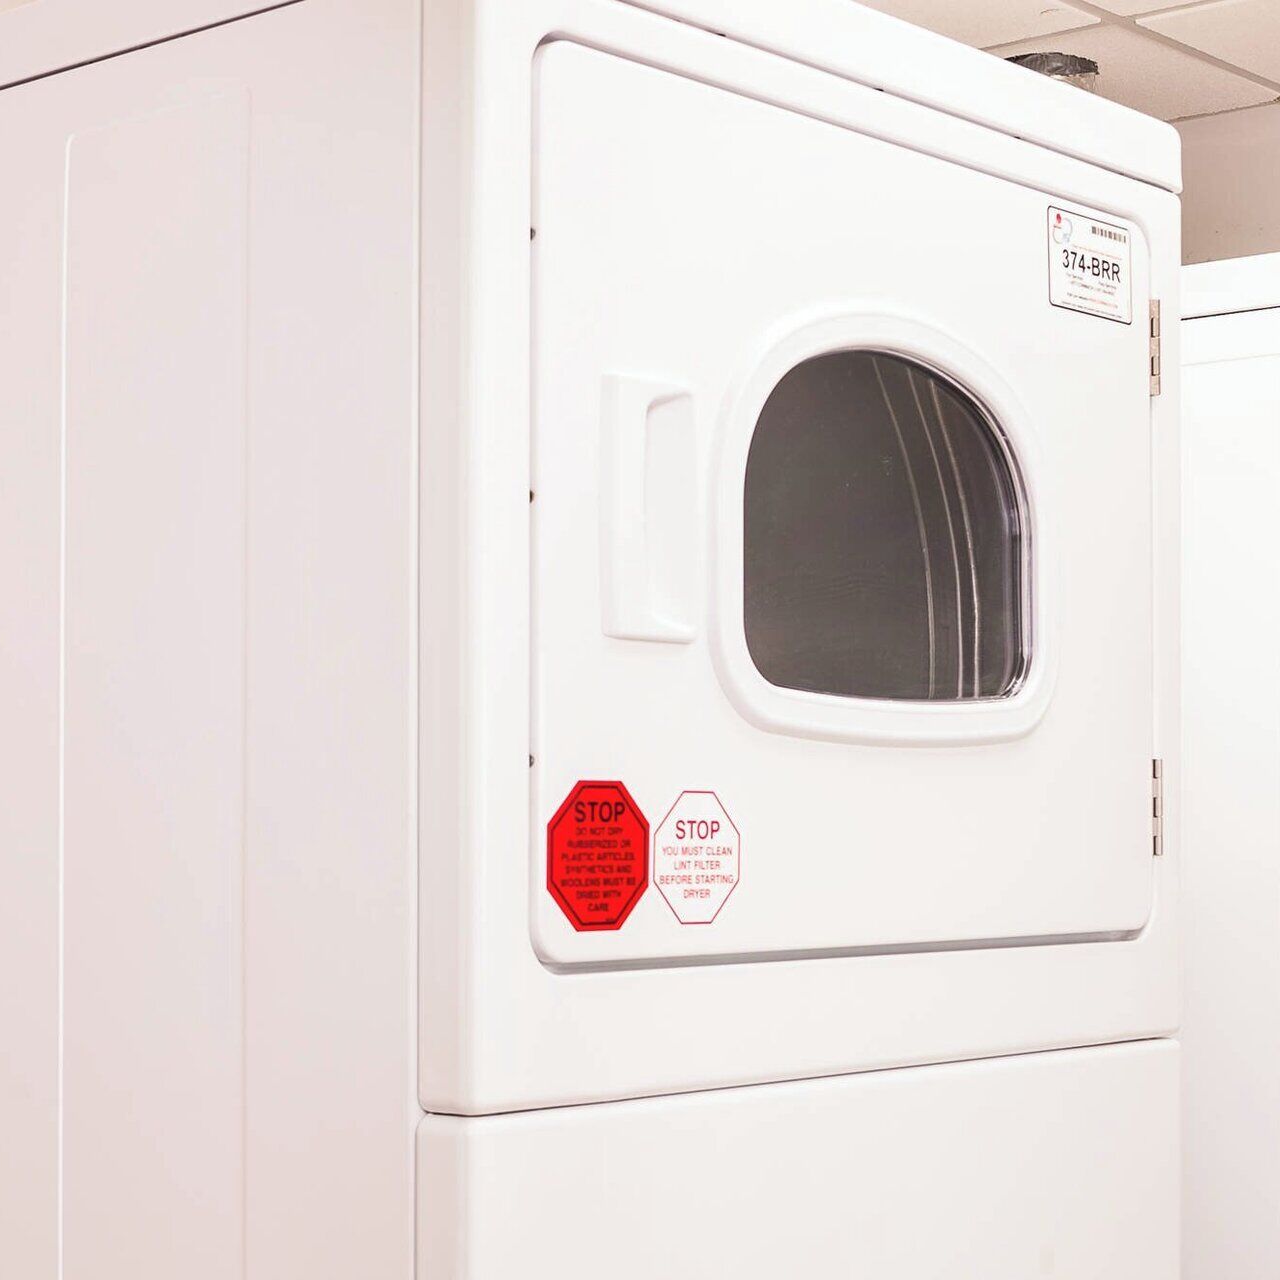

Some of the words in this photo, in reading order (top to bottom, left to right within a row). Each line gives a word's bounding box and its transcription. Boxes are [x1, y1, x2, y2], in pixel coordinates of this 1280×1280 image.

[1063, 249, 1120, 283] 374-BRR
[575, 802, 625, 822] STOP
[676, 820, 720, 839] STOP
[663, 847, 678, 855] YOU
[682, 847, 703, 855] MUST
[706, 847, 732, 855] CLEAN
[674, 861, 691, 870] LINT
[694, 861, 720, 870] FILTER
[660, 875, 692, 884] BEFORE
[695, 875, 734, 884] STARTING
[684, 889, 711, 898] DRYER
